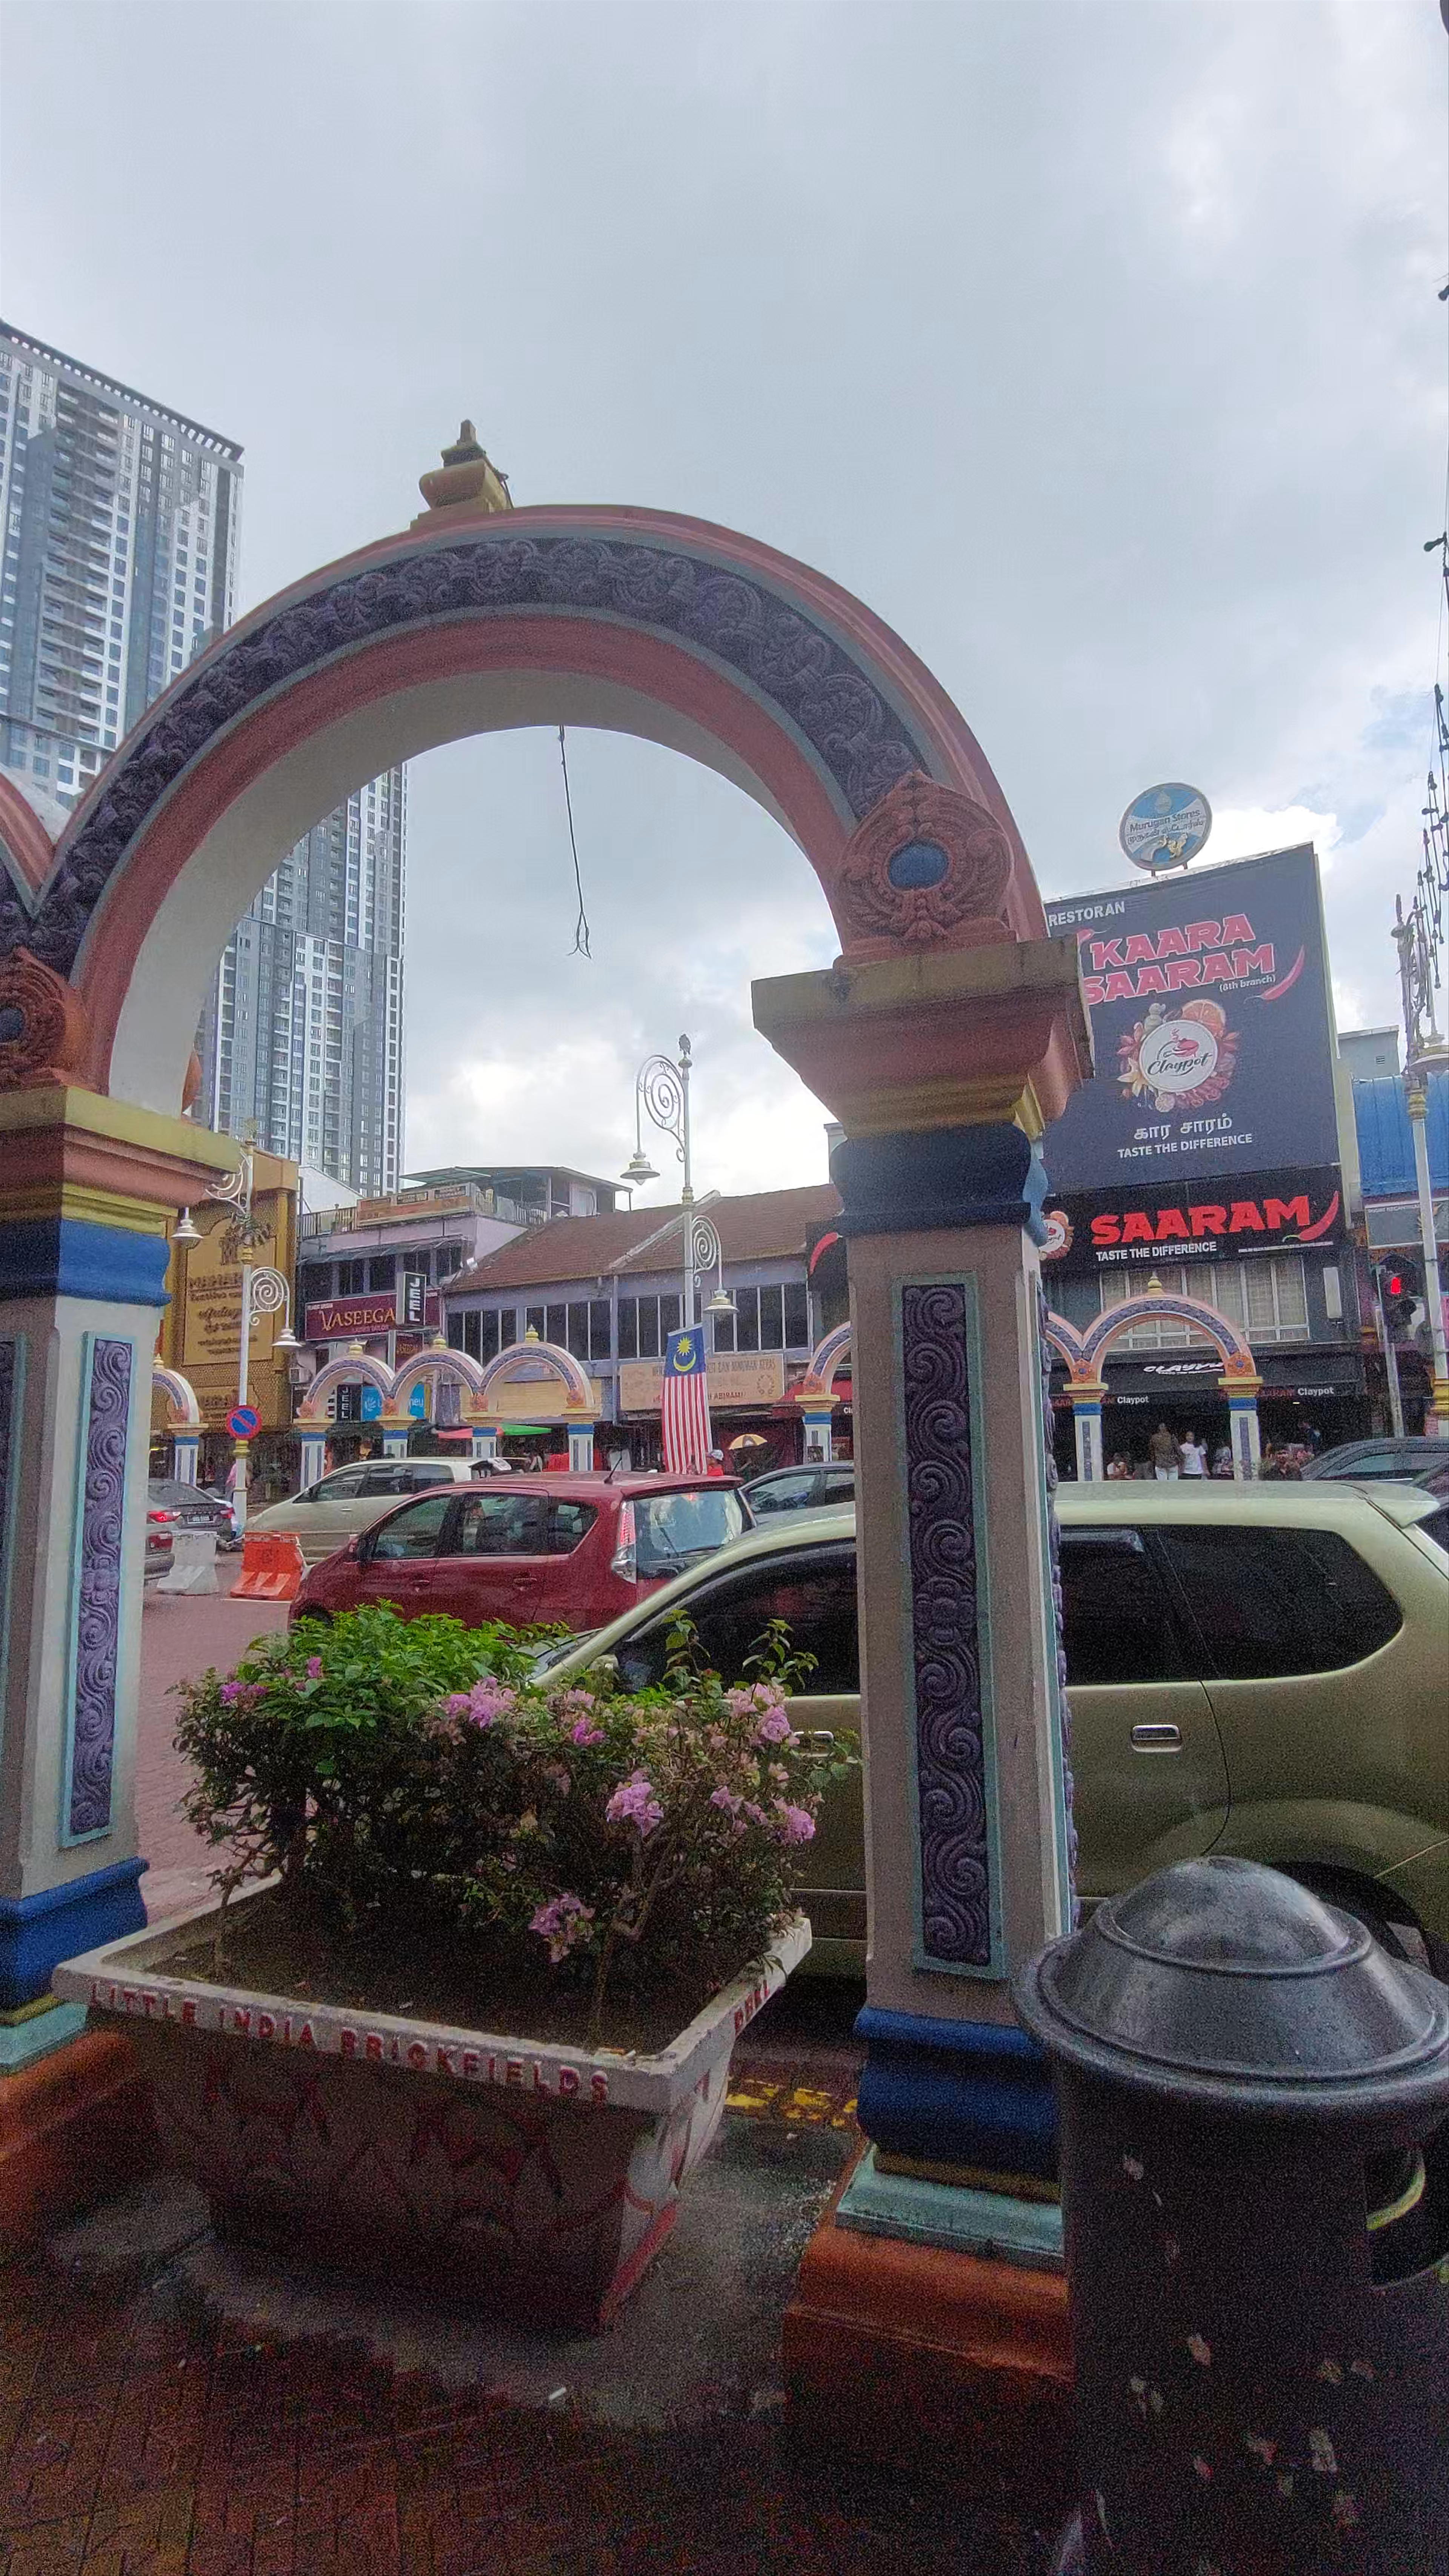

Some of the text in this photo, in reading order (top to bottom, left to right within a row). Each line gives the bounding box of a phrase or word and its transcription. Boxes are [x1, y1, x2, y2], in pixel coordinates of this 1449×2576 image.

[1130, 809, 1201, 833] Murugan Stores
[1048, 901, 1125, 927] RESTORAN
[1090, 913, 1256, 971] KAARA
[1083, 943, 1275, 1006] SAARAM
[1240, 973, 1276, 989] branch)
[1148, 1052, 1213, 1077] Claypot
[1134, 1113, 1232, 1140] கார சாரம்
[1117, 1133, 1253, 1159] TASTE THE DIFFERENCE
[1091, 1195, 1310, 1245] SAARAM
[1095, 1242, 1217, 1262] TASTE THE DIFFERENCE
[1117, 1395, 1149, 1405] Claypot
[1298, 1387, 1335, 1396] Claypot
[90, 1982, 609, 2102] LITTLE INDIA BRICKFIELDS
